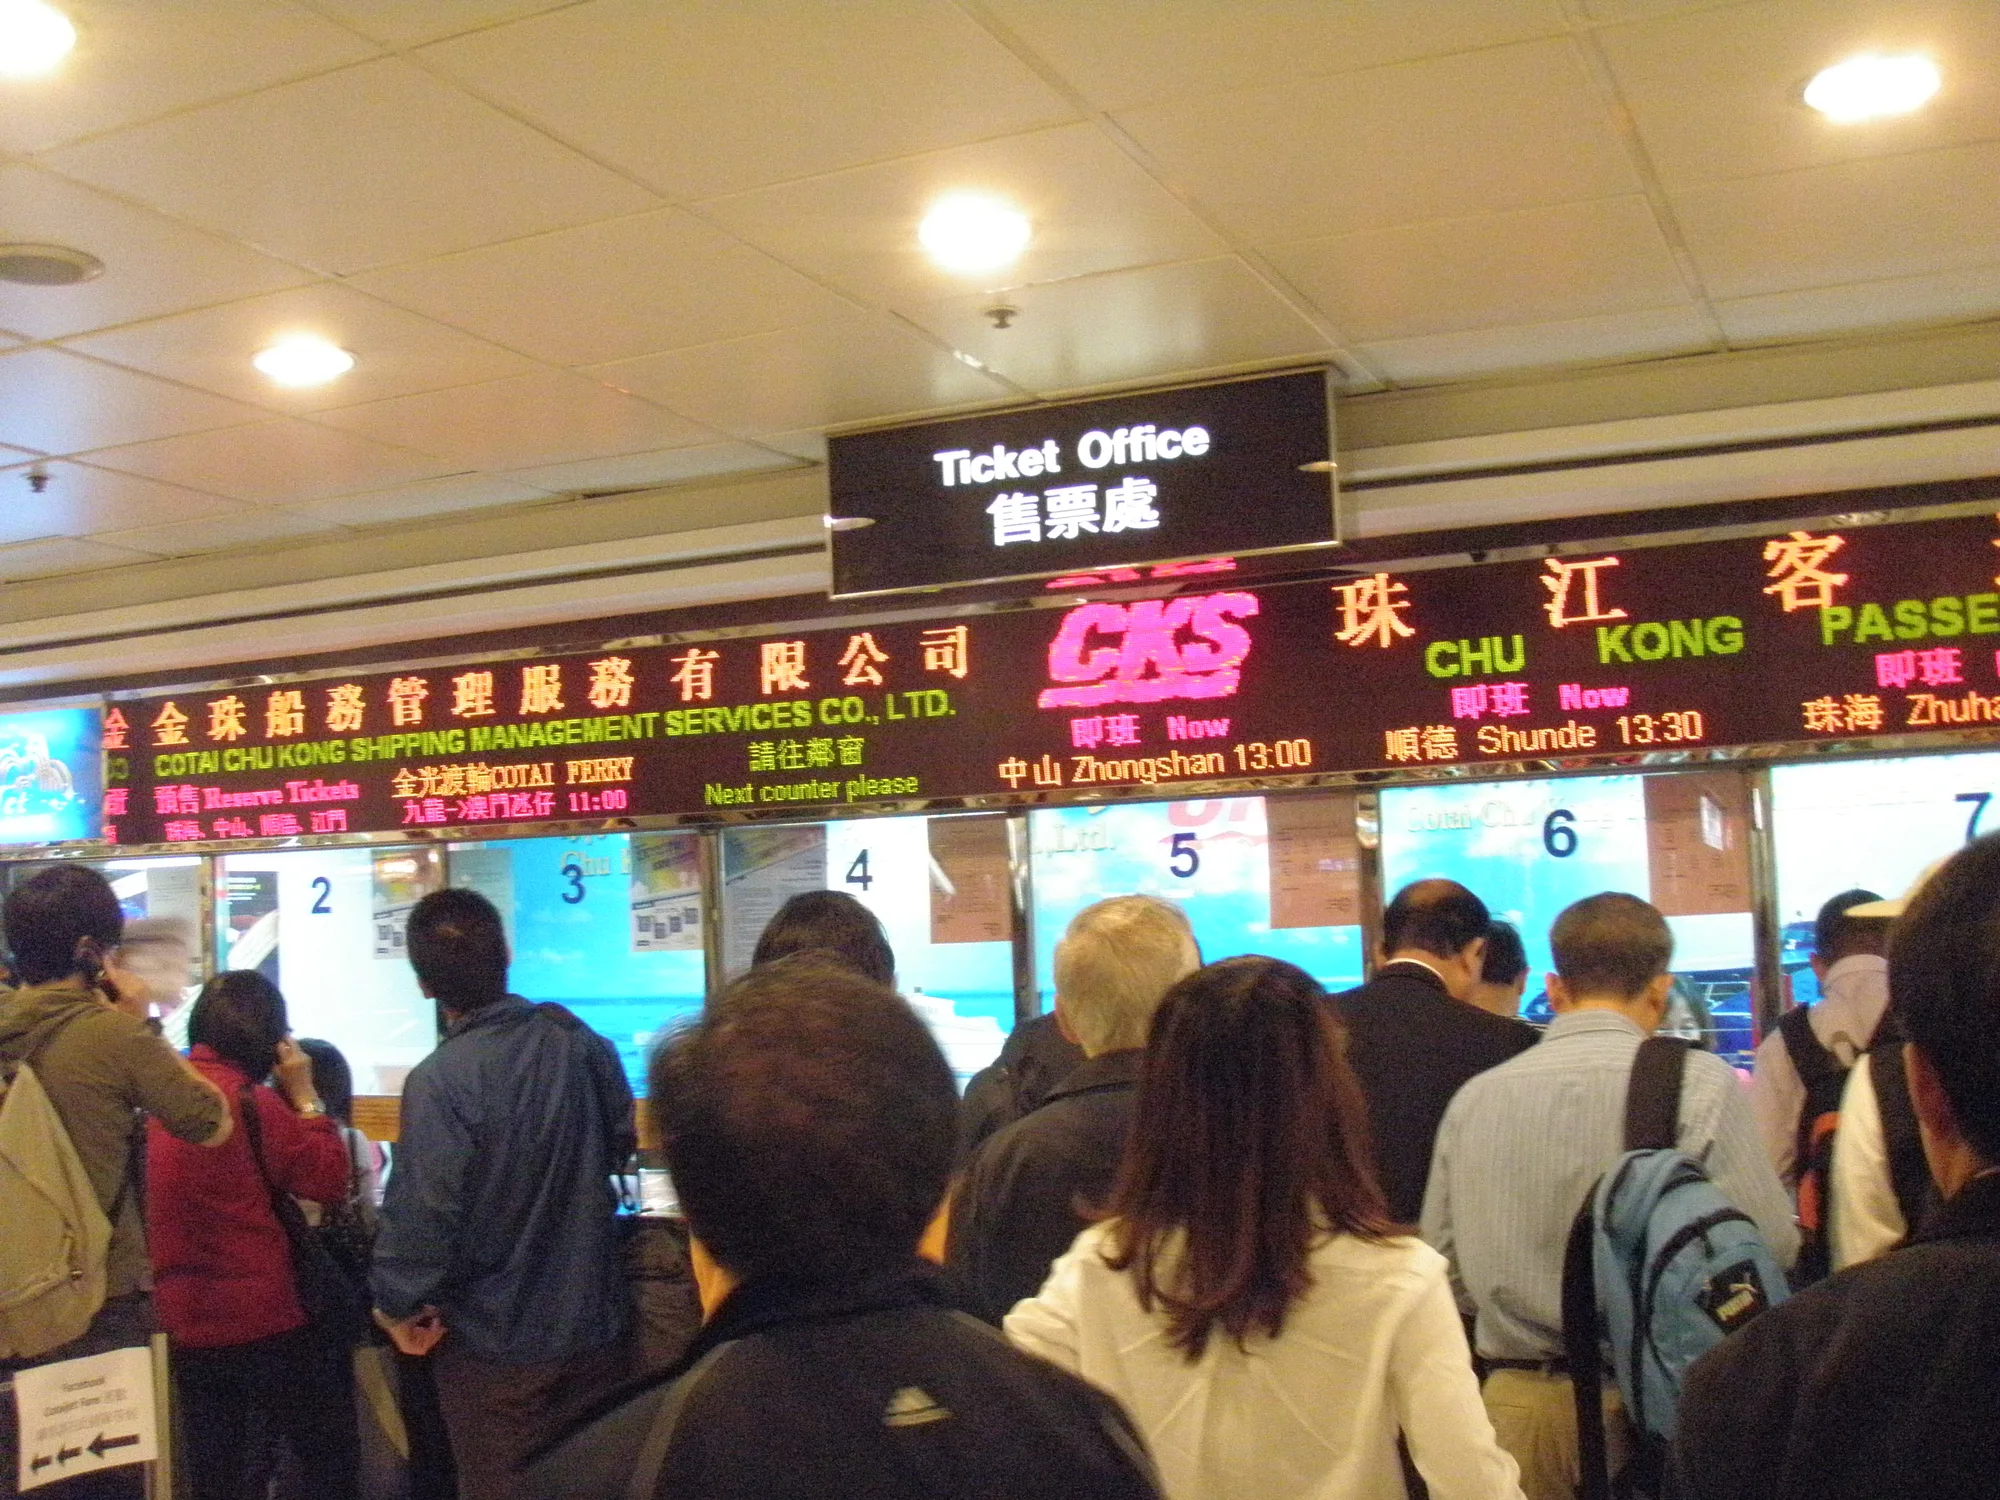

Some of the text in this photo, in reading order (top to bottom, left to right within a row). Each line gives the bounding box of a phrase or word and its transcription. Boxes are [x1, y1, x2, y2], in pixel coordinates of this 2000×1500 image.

[933, 424, 1210, 487] Ticket Office
[986, 477, 1161, 546] 售票處
[1048, 591, 1260, 683] CKS
[1425, 635, 1526, 678] CHU
[1596, 616, 1744, 665] KONG
[1558, 684, 1630, 711] Now
[1801, 693, 1885, 733] 珠海
[153, 752, 219, 777] COTAI
[223, 746, 273, 772] CHU
[277, 740, 346, 768] KONG
[351, 728, 466, 762] SHIPPING
[469, 712, 661, 752] MANAGEMENT
[664, 700, 813, 737] SERVICES
[818, 696, 880, 725] CO.,
[885, 688, 957, 720] LTD.
[1166, 715, 1231, 741] Now
[1385, 710, 1704, 761] 順德 Shunde 13:30
[566, 757, 635, 784] FERRY
[998, 739, 1313, 789] 中山 Zhongshan 13:00
[203, 787, 284, 810] Reserve
[285, 779, 360, 805] Tickets
[568, 789, 629, 812] 11:00
[705, 774, 920, 805] Next counter please
[1543, 808, 1578, 858] 6
[1955, 791, 1993, 842] 7
[846, 848, 873, 891] 4
[1169, 832, 1200, 878] 5
[311, 876, 333, 915] 2
[561, 864, 586, 905] 3
